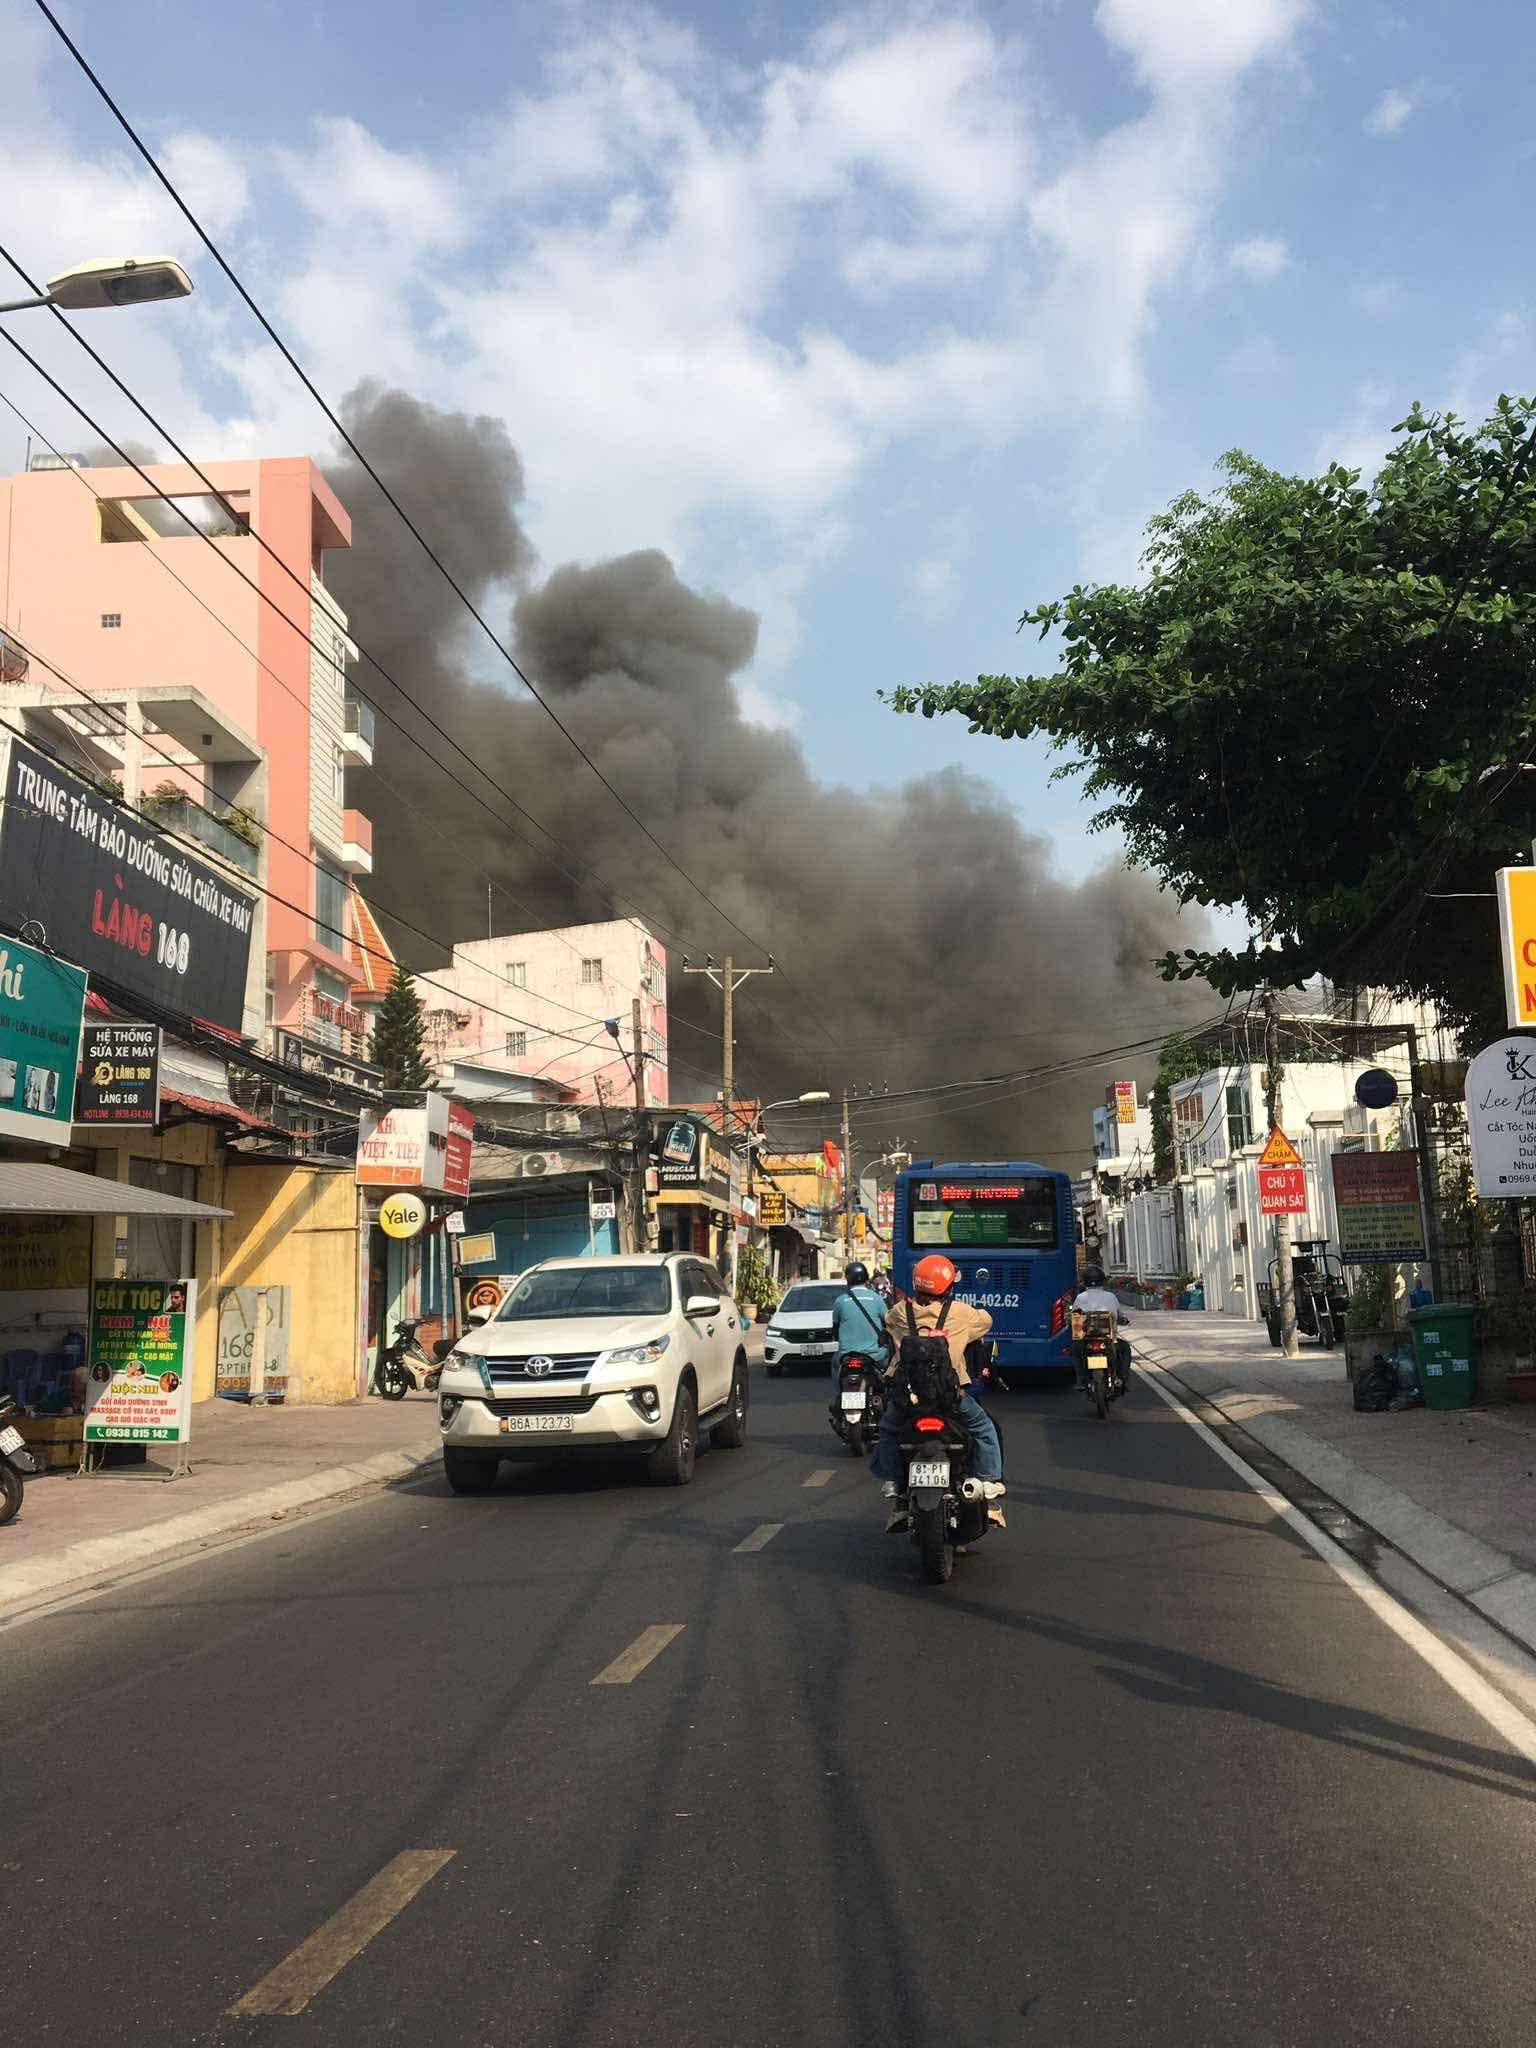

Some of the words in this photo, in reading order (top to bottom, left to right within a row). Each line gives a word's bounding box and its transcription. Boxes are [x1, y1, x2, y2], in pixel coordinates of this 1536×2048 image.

[17, 761, 67, 822] TRUNG
[69, 794, 98, 842] TÂM
[99, 814, 126, 859] BẢO
[127, 835, 170, 886] DƯỠNG
[170, 859, 192, 900] SỬA
[193, 879, 218, 915] CHỮA
[218, 893, 232, 924] XE
[231, 899, 251, 934] MÁY
[91, 873, 153, 957] LÀNG
[157, 922, 190, 974] 168
[96, 1028, 111, 1045] HỆ
[114, 1027, 152, 1042] THỐNG
[89, 1043, 112, 1057] SỬA
[115, 1047, 129, 1057] XE
[132, 1044, 156, 1057] MÁY
[99, 1091, 121, 1104] LÀNG
[123, 1094, 138, 1104] 168
[1479, 1088, 1512, 1111] Lee
[1488, 1122, 1504, 1132] Cắt
[662, 1165, 695, 1173] MUSCLE
[663, 1173, 697, 1182] STATION
[1267, 1173, 1286, 1189] CHÚ
[1289, 1173, 1296, 1189] Ý
[1262, 1195, 1287, 1208] QUAN
[1288, 1192, 1304, 1207] SÁT
[384, 1208, 418, 1224] Yale
[96, 1286, 127, 1310] CẮT
[130, 1286, 161, 1310] TÓC
[106, 1428, 130, 1438] 0938
[132, 1429, 150, 1438] 015
[152, 1429, 169, 1439] 142
